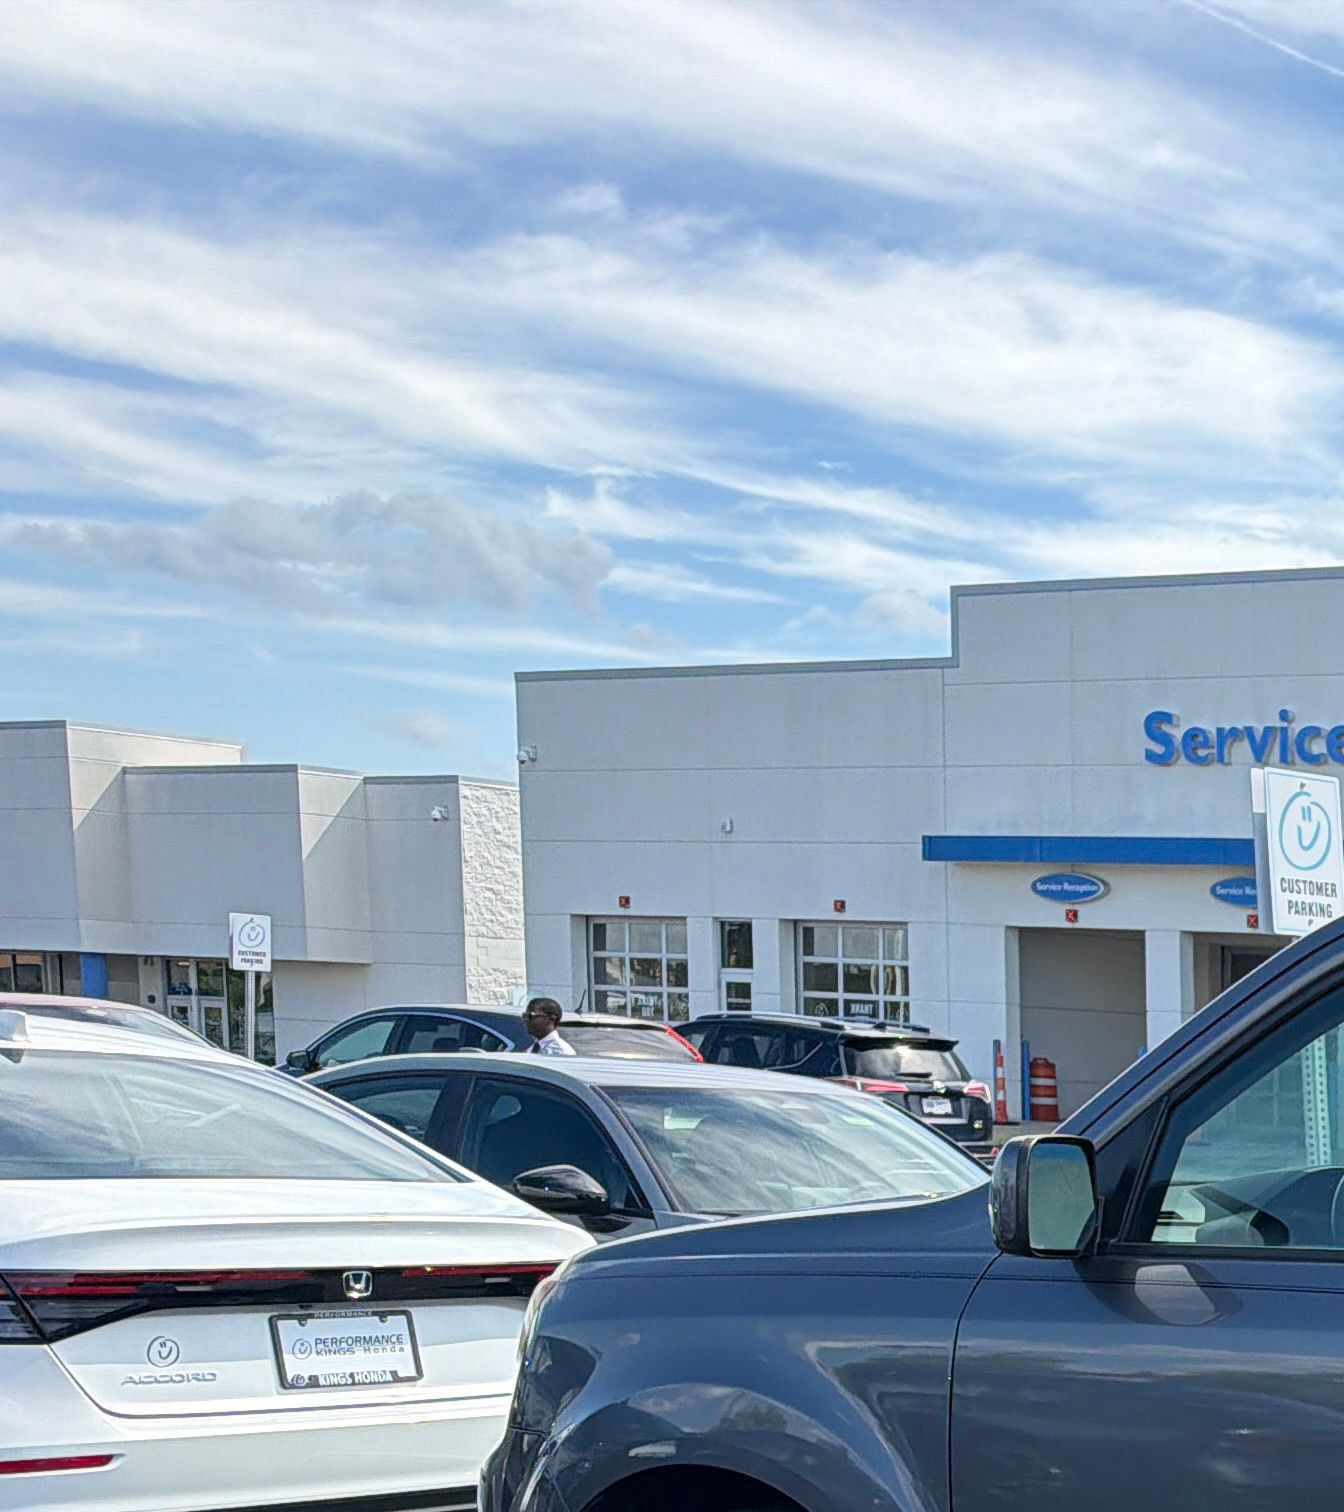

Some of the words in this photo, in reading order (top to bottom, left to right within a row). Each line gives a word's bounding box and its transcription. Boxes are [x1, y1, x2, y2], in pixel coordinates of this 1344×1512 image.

[1036, 882, 1062, 891] Service
[1063, 882, 1098, 893] Reception
[1216, 885, 1243, 896] Service
[1280, 877, 1337, 899] CUSTOMER
[1287, 900, 1333, 918] PARKING
[315, 1334, 404, 1348] PERFORMANCE
[316, 1347, 356, 1357] KINGS
[364, 1345, 405, 1355] Honda
[120, 1372, 217, 1386] ACCORD
[319, 1373, 352, 1386] KINGS
[353, 1370, 393, 1384] HONDA
